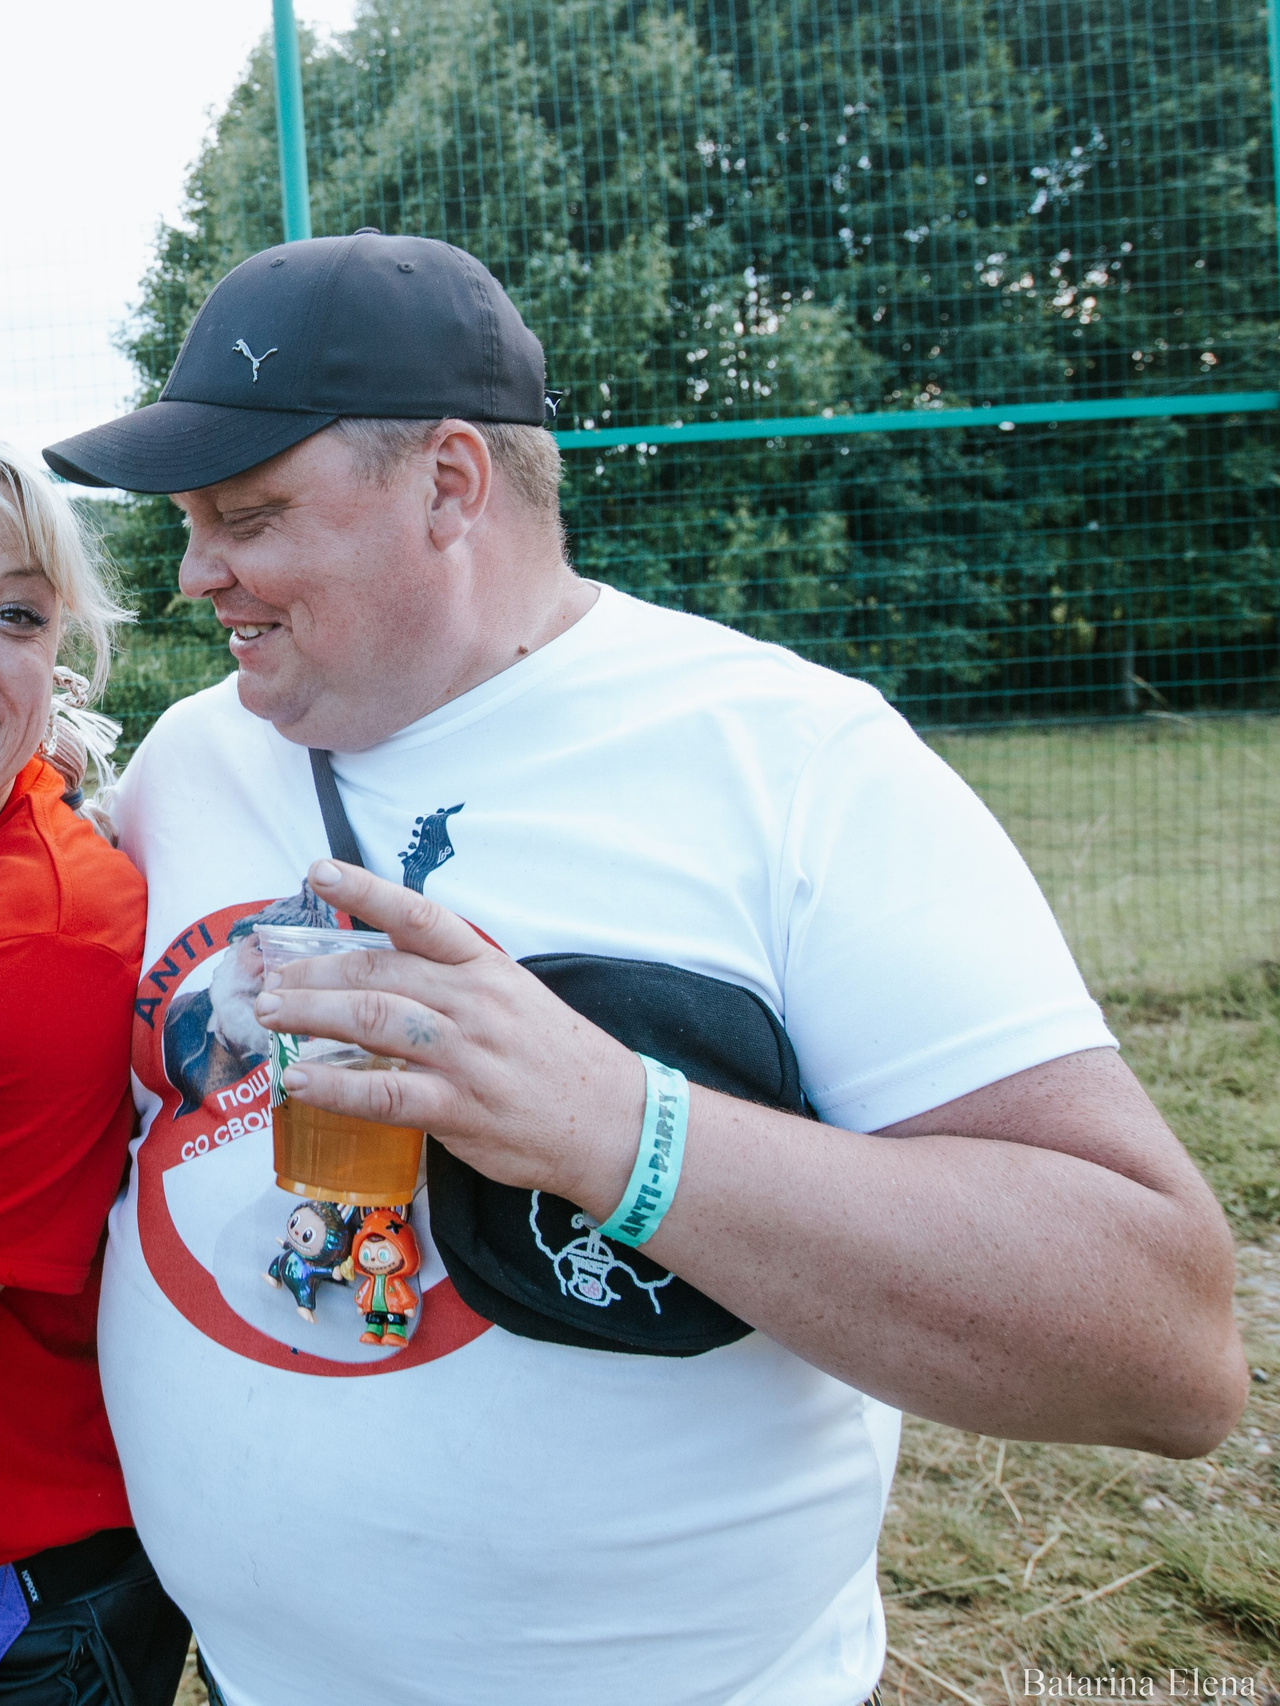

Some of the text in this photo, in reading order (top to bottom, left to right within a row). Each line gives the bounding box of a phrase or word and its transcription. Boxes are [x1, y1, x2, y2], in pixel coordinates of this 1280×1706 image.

[133, 921, 214, 1031] ANTI
[181, 1133, 210, 1162] СО
[618, 1089, 677, 1238] ANTI-PARTY
